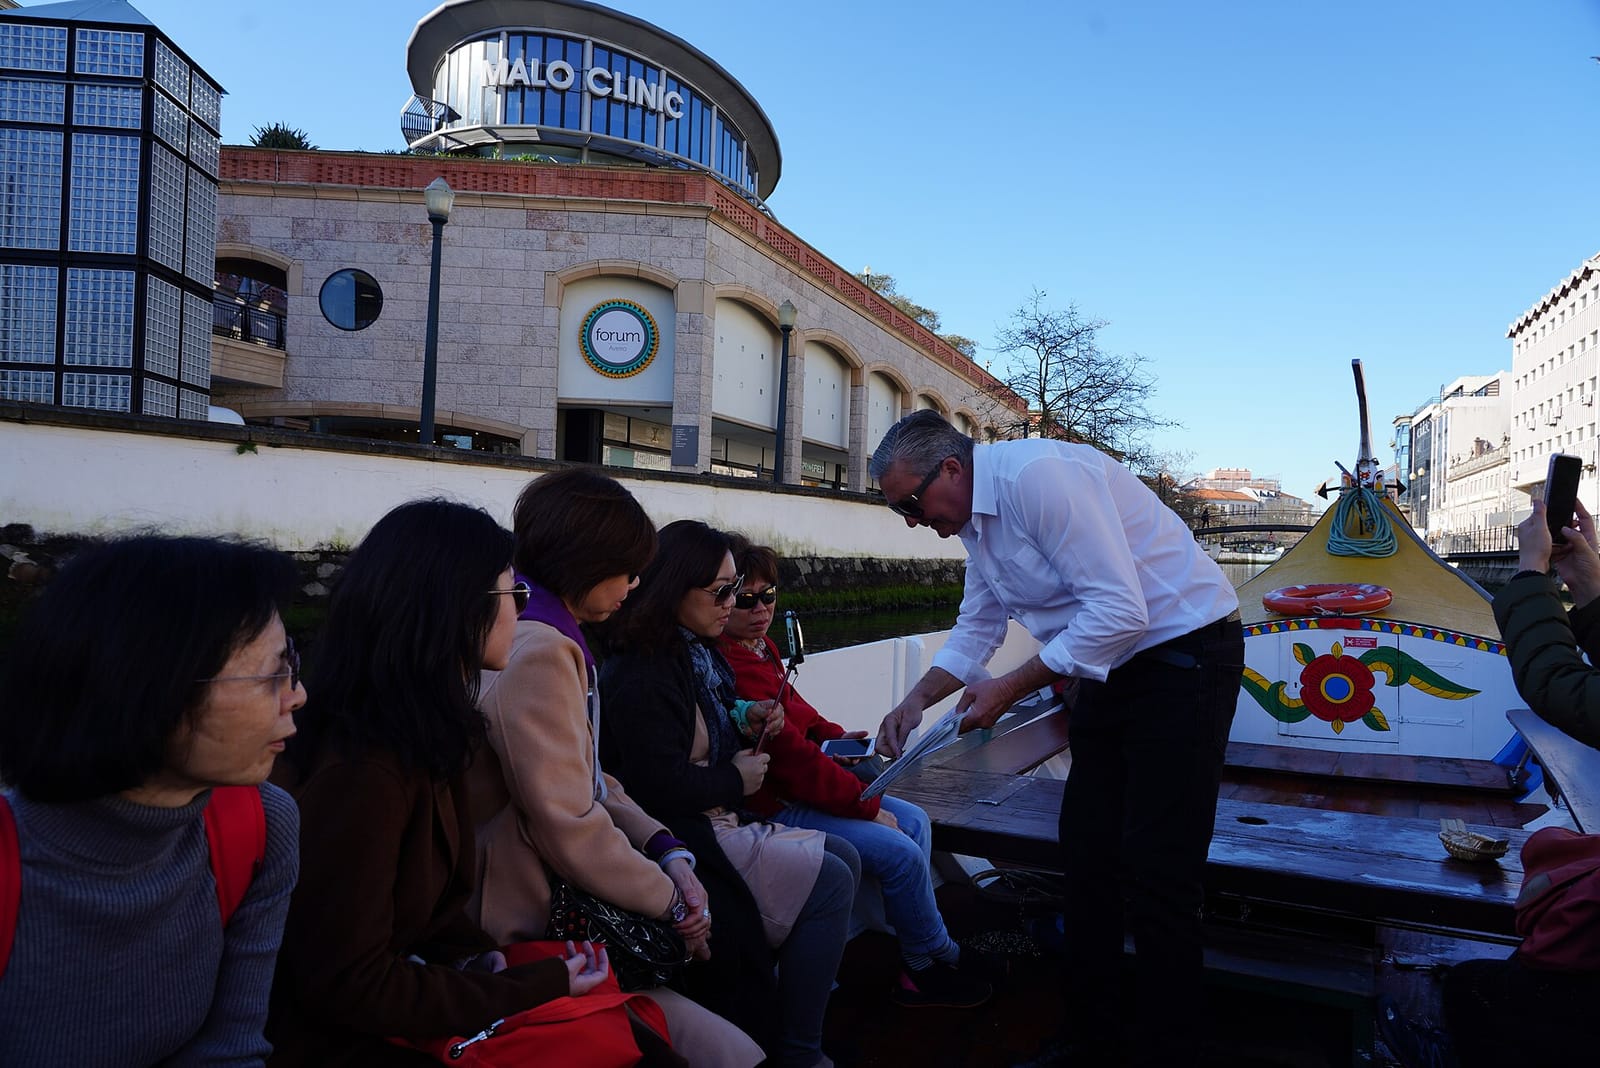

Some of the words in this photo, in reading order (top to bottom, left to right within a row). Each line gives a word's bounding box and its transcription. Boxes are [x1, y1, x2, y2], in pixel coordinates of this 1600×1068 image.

[481, 57, 575, 90] MALO
[587, 67, 684, 119] CLINIC
[596, 328, 640, 342] forum
